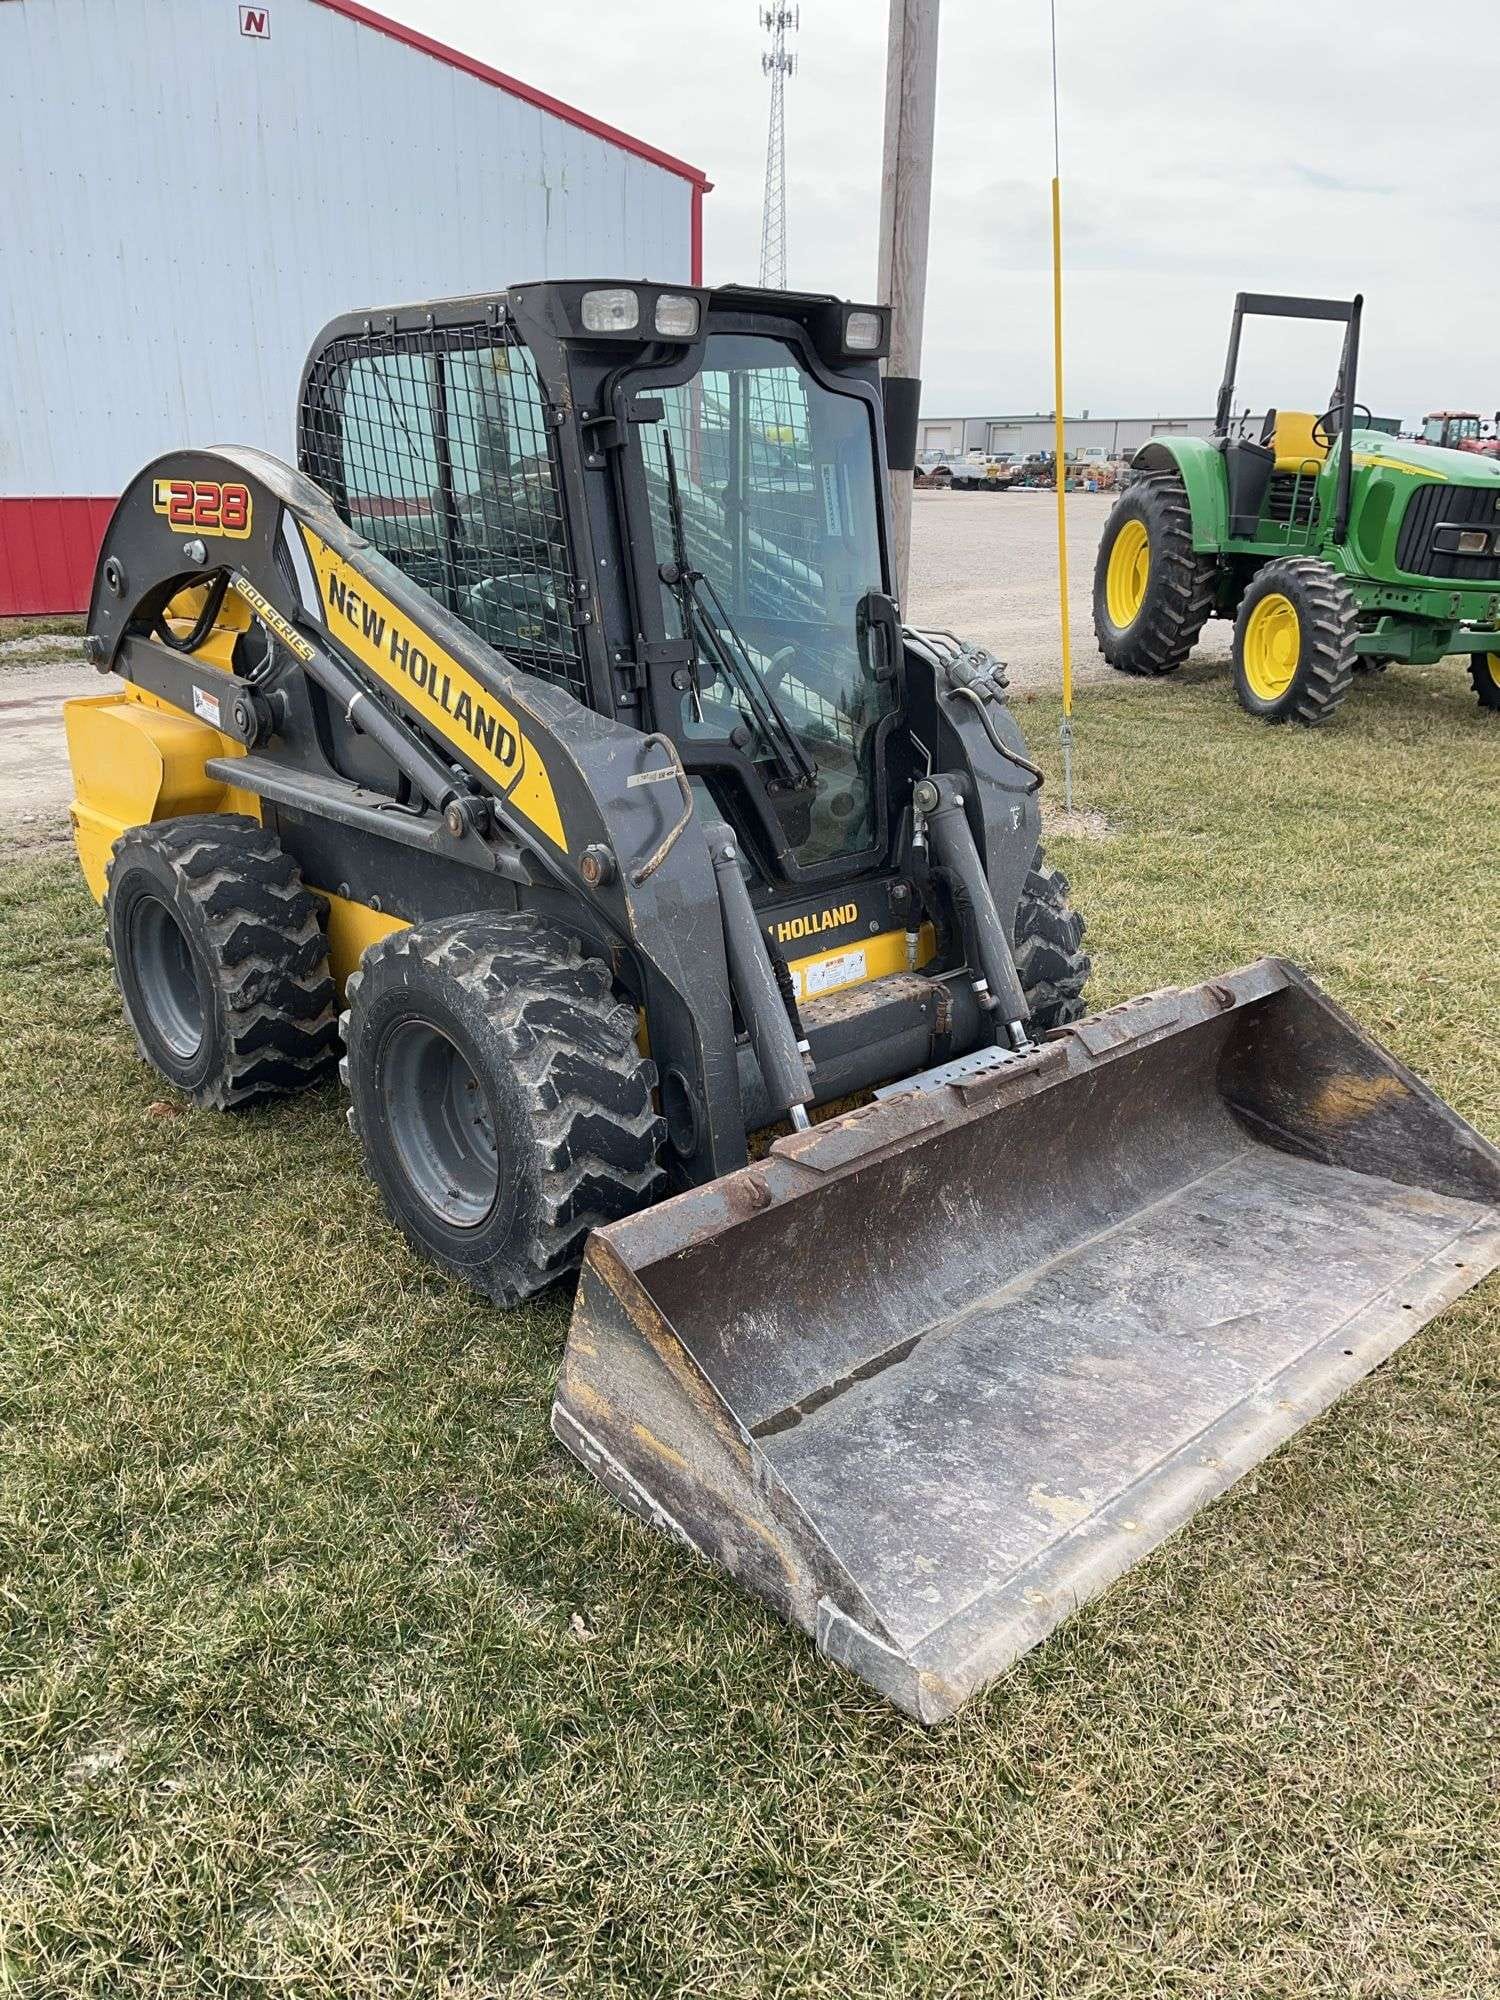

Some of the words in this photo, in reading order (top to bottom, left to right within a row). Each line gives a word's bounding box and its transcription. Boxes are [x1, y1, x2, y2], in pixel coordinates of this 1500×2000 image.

[245, 11, 265, 32] N
[237, 578, 265, 611] 200
[266, 609, 316, 662] SERIES
[328, 572, 386, 648] NEW
[389, 628, 517, 768] HOLLAND
[777, 903, 858, 943] HOLLAND
